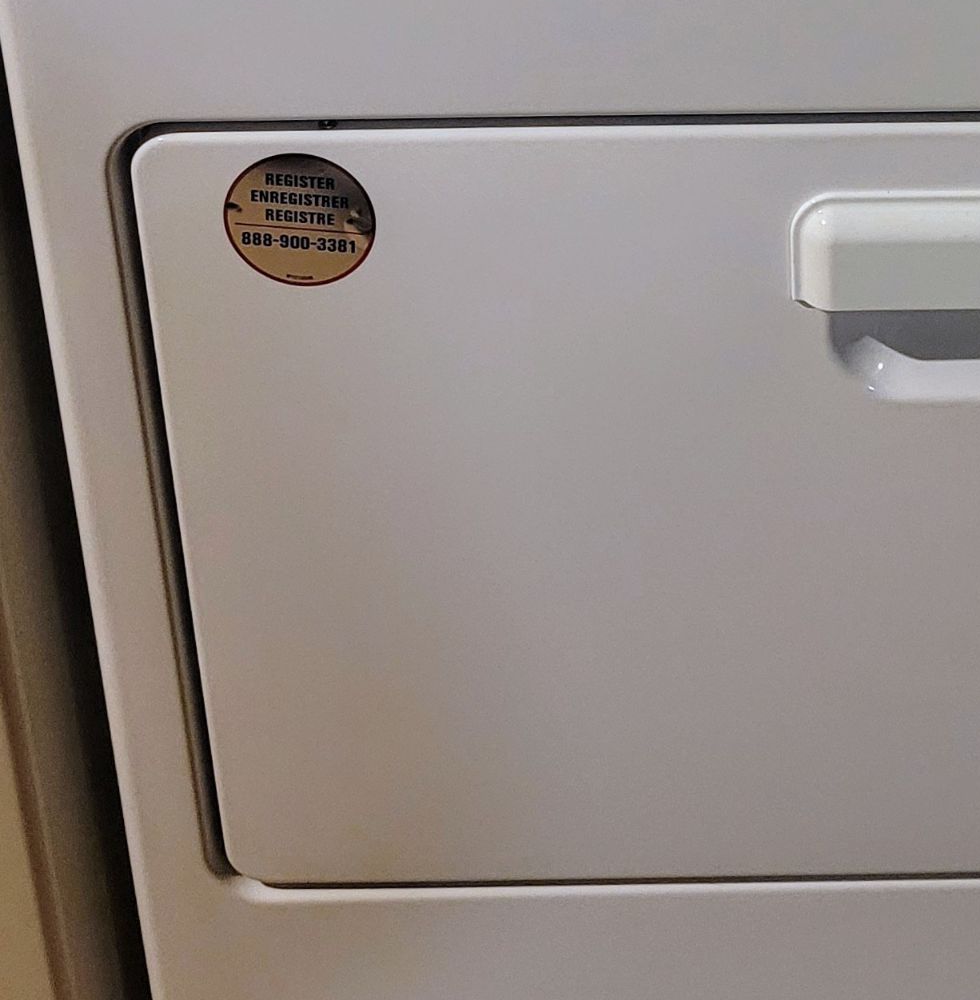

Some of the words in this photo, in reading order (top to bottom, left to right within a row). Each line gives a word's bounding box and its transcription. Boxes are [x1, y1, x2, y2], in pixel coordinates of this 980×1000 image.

[265, 172, 336, 191] REGISTER
[250, 189, 351, 210] ENREGISTRER
[265, 208, 336, 226] REGISTRE
[241, 231, 357, 254] 888-900-3381
